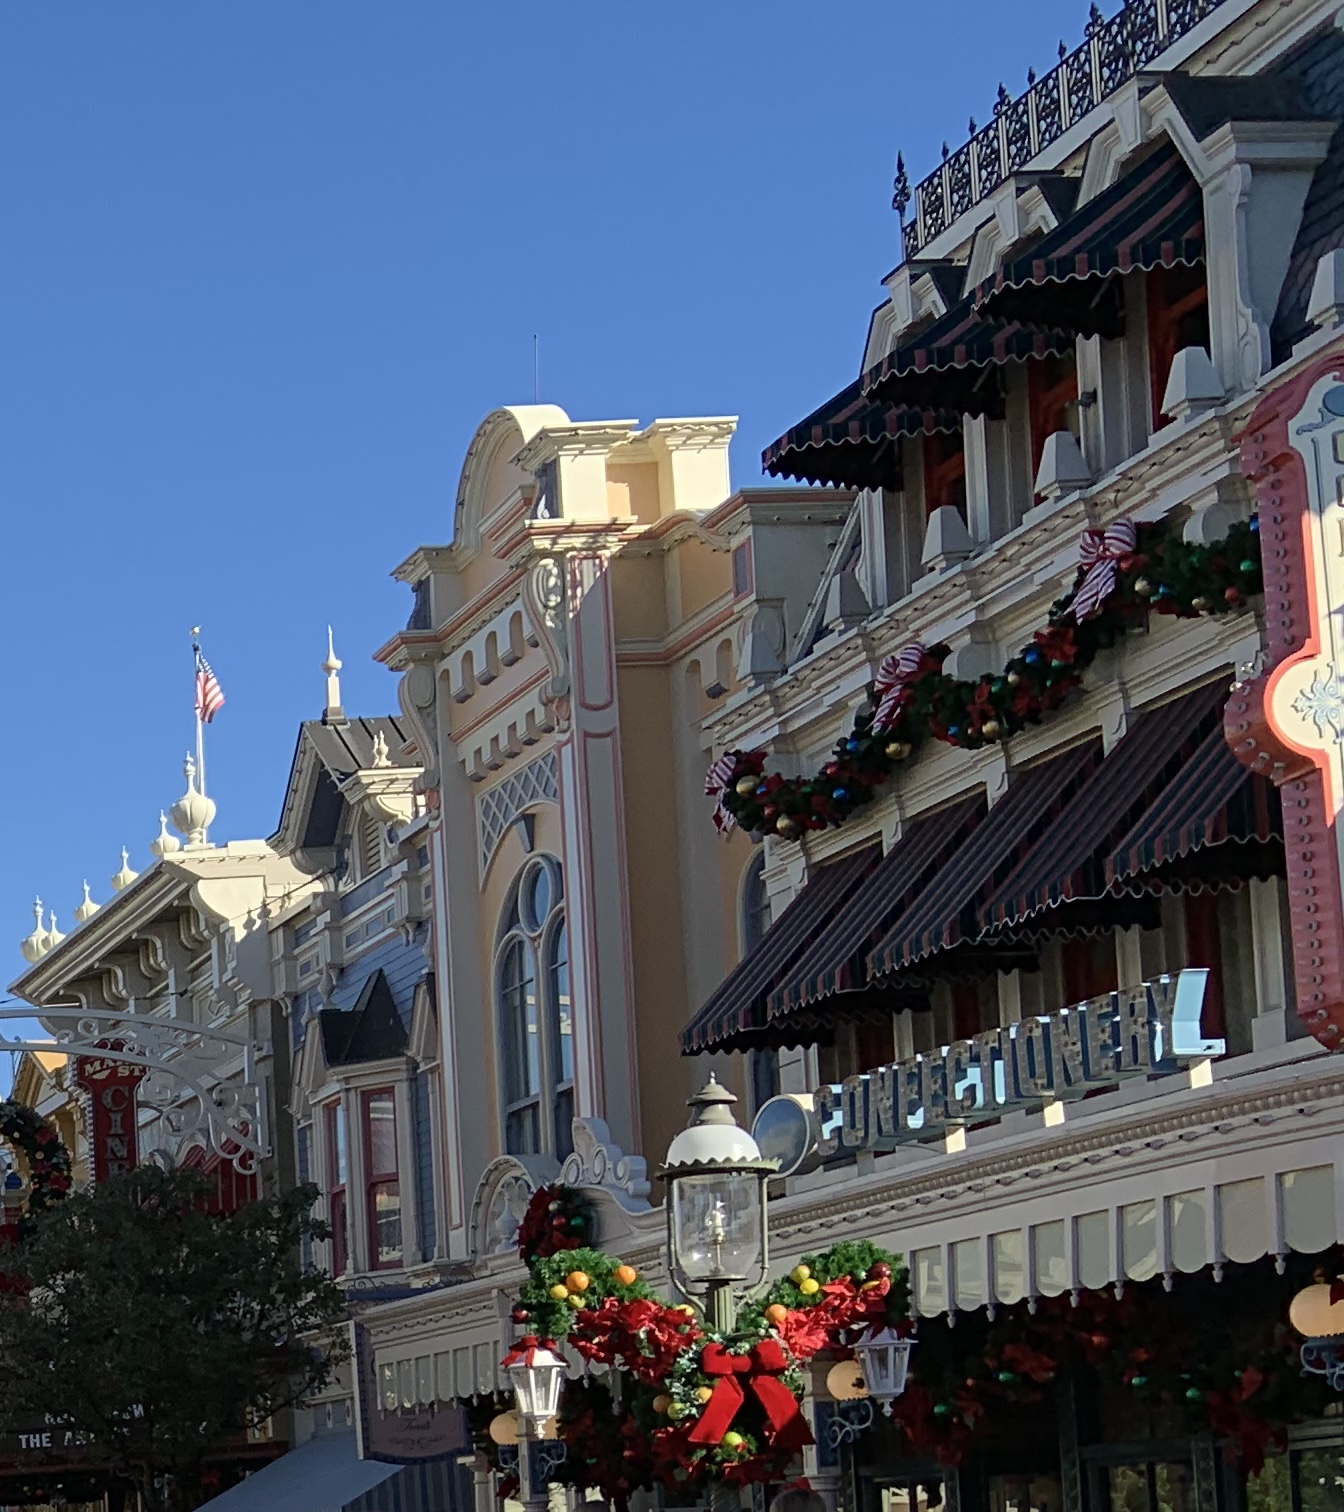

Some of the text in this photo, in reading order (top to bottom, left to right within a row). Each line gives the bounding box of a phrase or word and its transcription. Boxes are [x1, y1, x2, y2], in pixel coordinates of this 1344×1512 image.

[812, 968, 1226, 1155] CONFECTIONERY
[102, 1085, 130, 1177] CINE
[18, 1433, 52, 1449] THE
